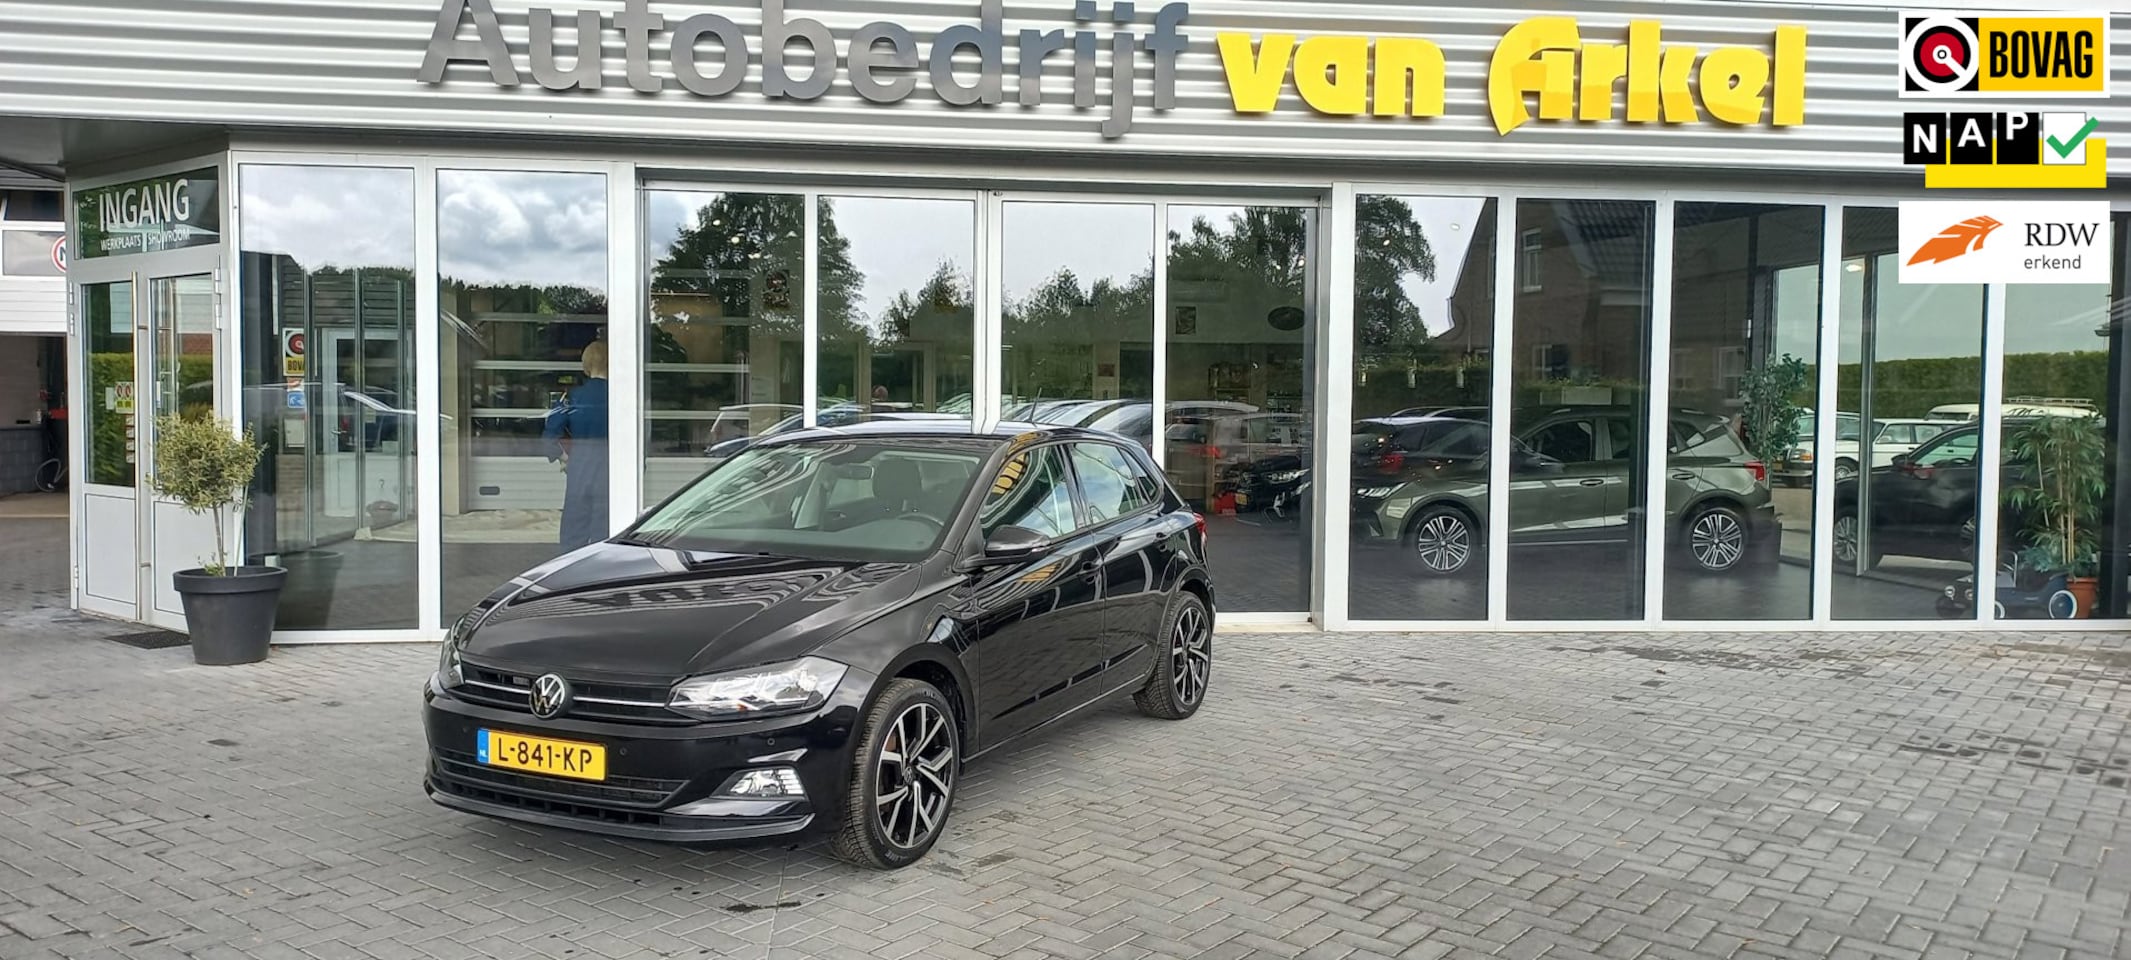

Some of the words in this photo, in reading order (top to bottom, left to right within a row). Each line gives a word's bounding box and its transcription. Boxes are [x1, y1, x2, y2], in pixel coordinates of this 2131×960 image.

[416, 0, 1189, 138] Autobedrijf
[1216, 31, 1446, 117] van
[1488, 16, 1807, 136] Arkel
[99, 178, 190, 232] INGANG
[100, 234, 142, 251] WERKPLAATS
[147, 228, 191, 245] SHOWROOM
[498, 737, 593, 773] L-841-KP
